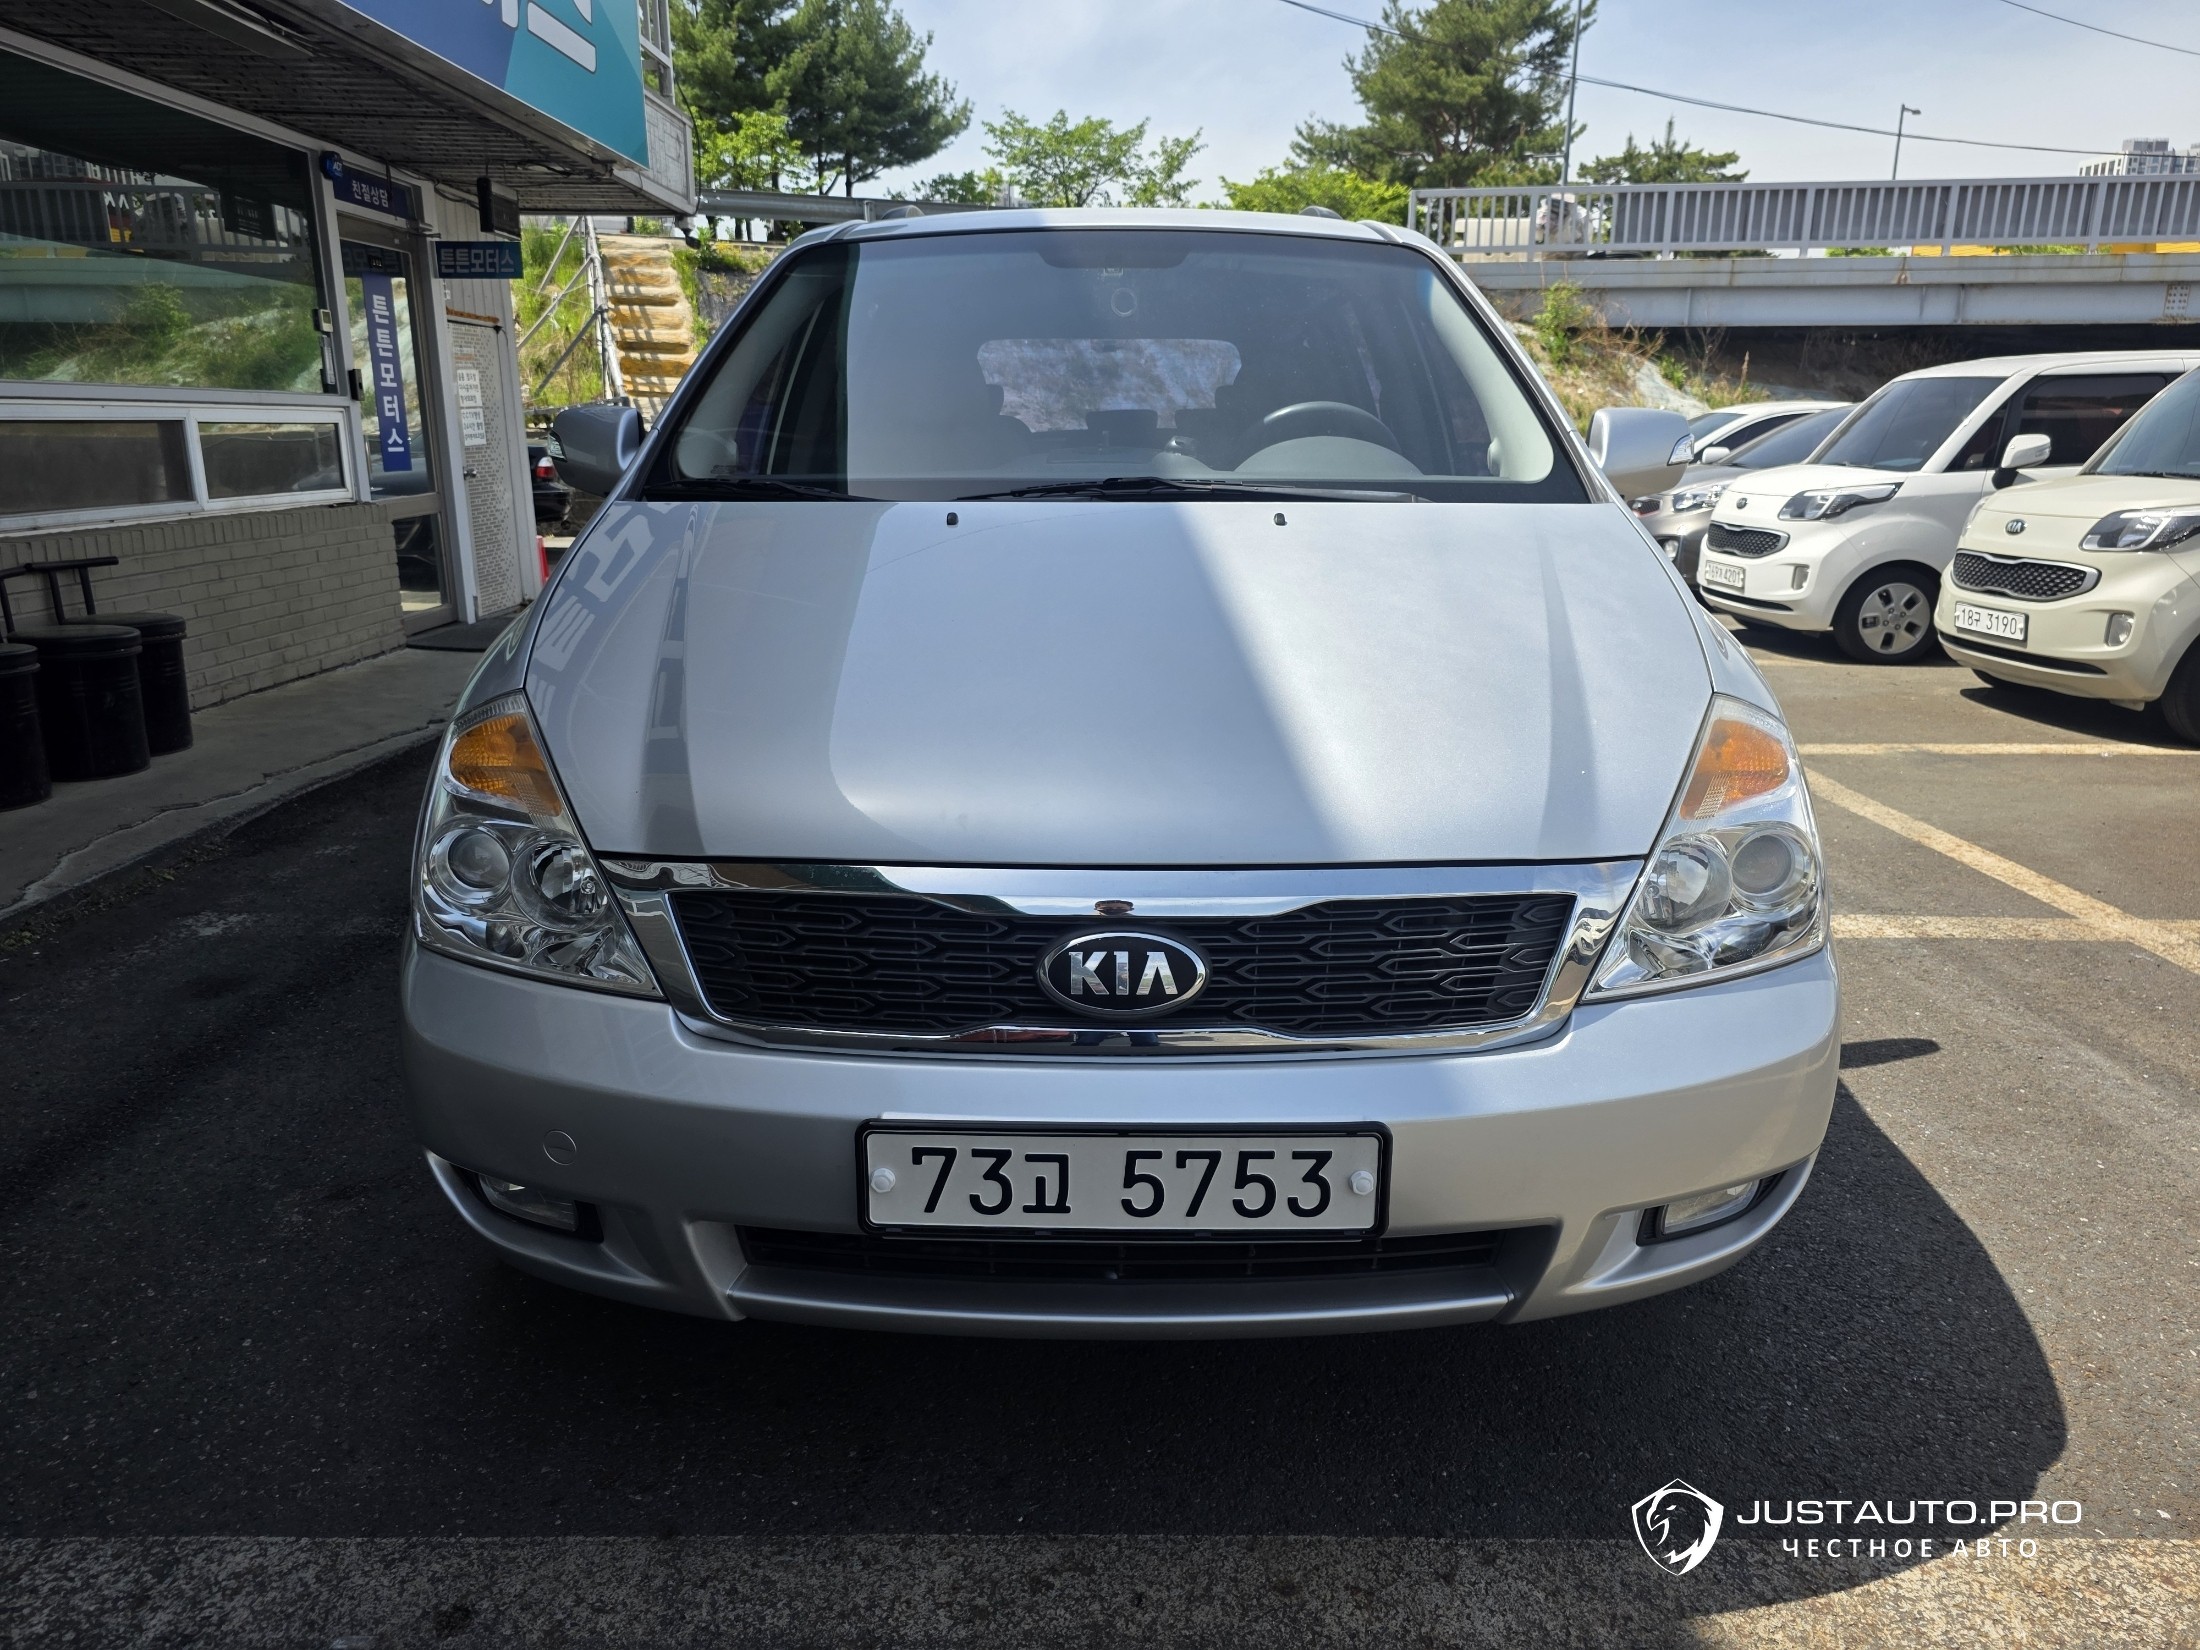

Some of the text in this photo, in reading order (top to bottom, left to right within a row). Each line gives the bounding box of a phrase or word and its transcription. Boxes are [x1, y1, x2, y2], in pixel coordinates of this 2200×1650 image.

[440, 248, 515, 274] 튼튼모터스
[372, 294, 405, 453] 튼튼모터스
[1962, 608, 2018, 635] 18구 3190
[1067, 950, 1180, 996] KIA
[911, 1146, 1334, 1218] 73고 5753
